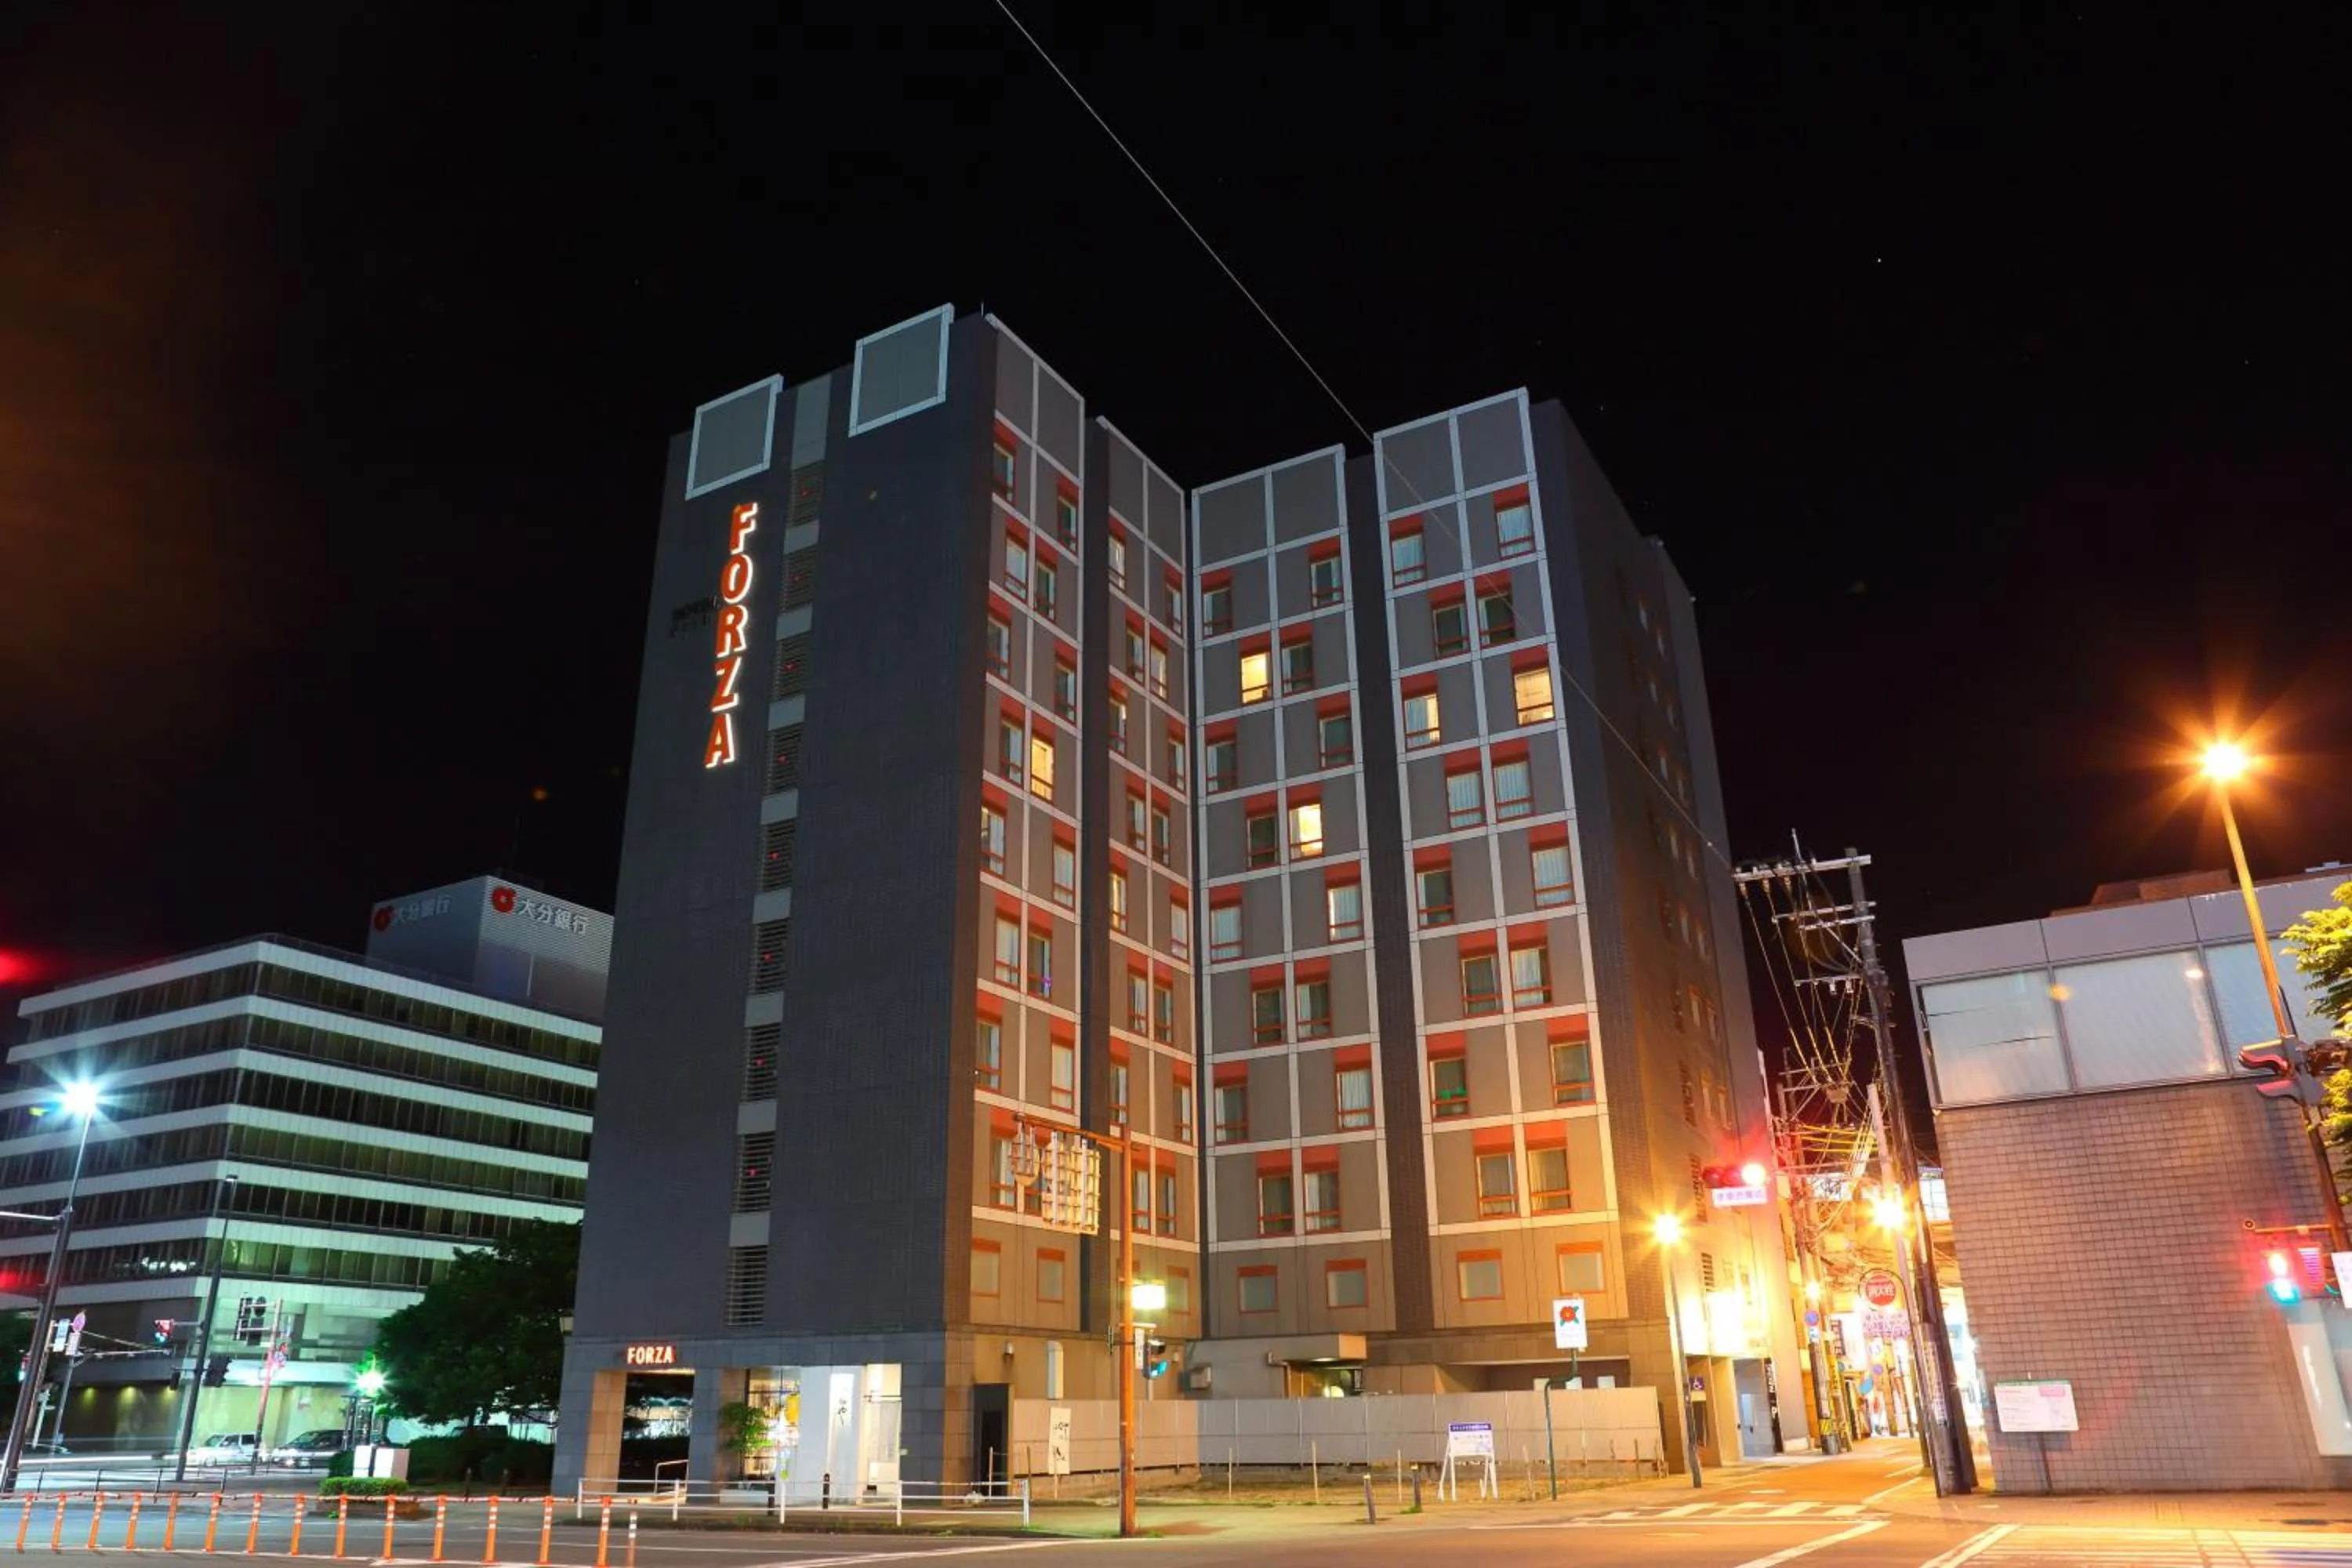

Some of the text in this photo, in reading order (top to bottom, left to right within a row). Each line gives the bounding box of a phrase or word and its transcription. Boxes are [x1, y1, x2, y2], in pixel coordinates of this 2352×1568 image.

[704, 502, 758, 768] FORZA
[518, 899, 588, 935] 大分銀行
[627, 1345, 675, 1364] FORZA
